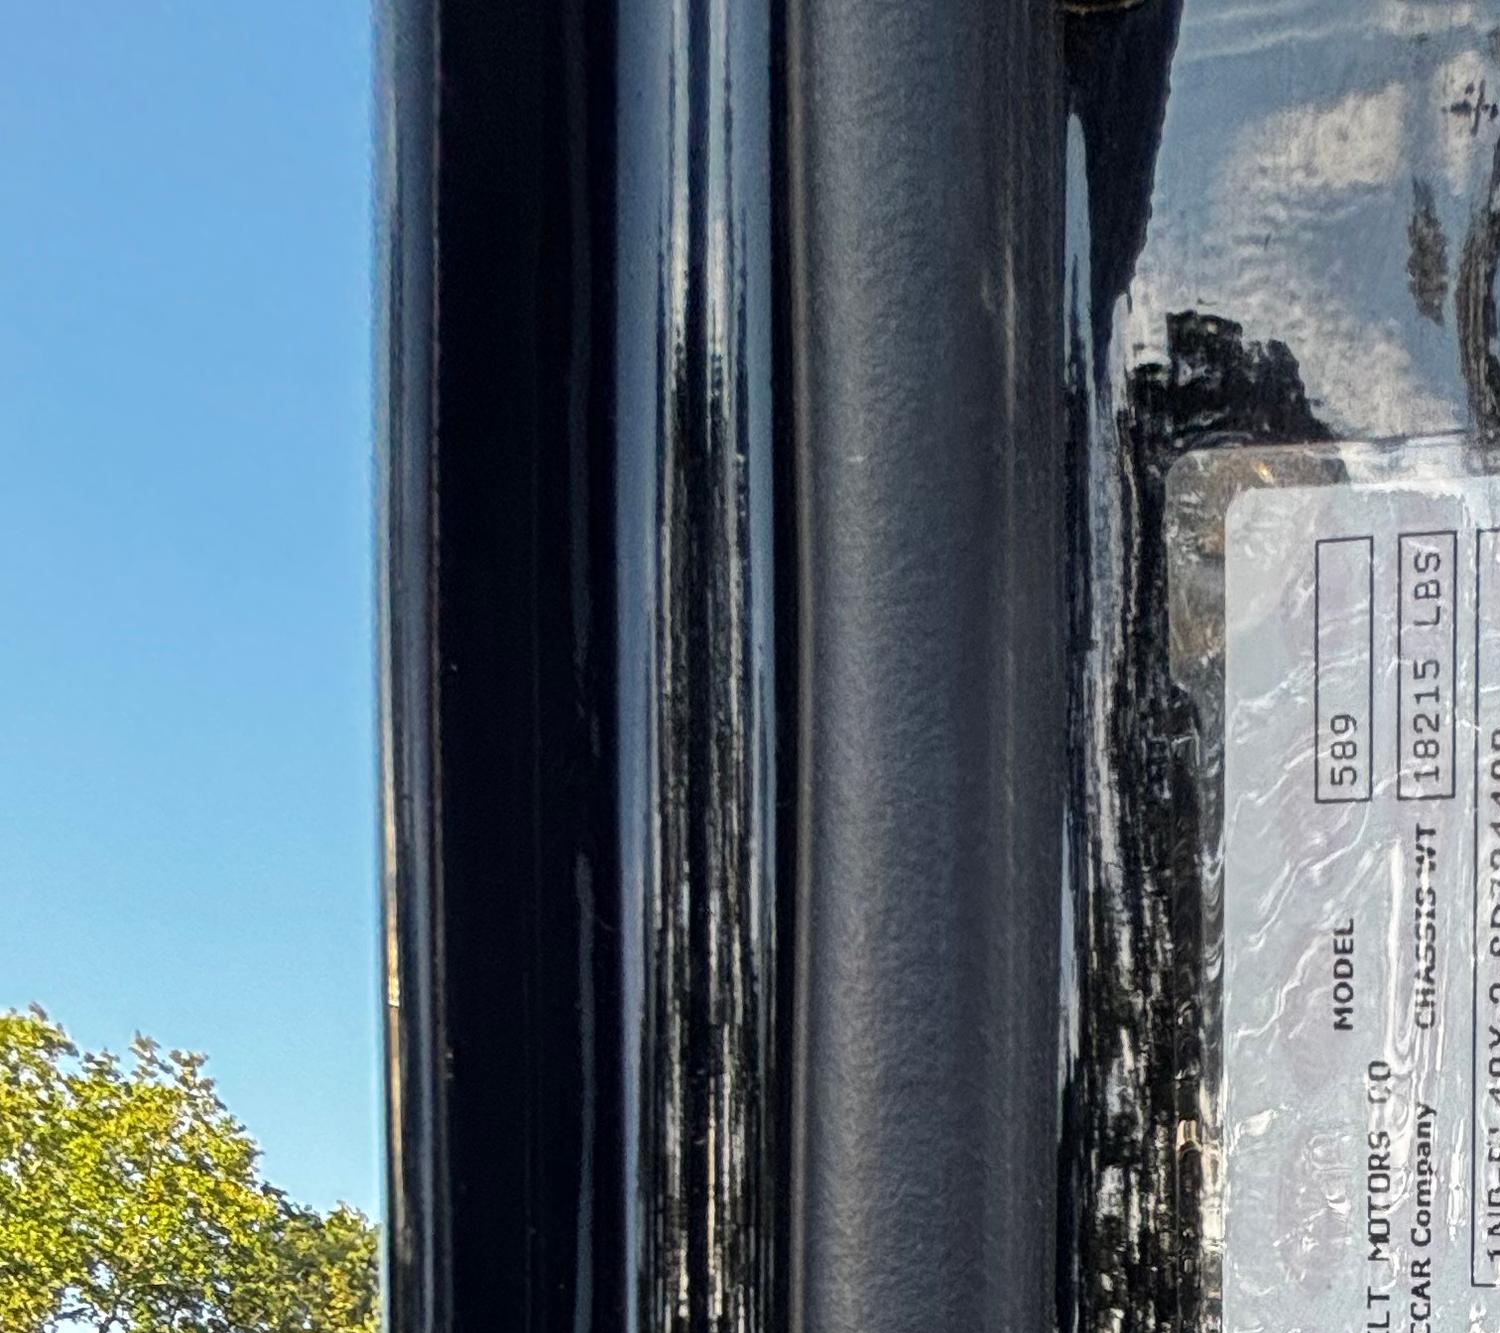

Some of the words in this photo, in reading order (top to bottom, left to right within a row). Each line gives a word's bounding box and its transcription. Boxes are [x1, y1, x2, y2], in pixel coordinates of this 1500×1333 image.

[1412, 550, 1442, 625] LBS
[1329, 712, 1358, 786] 589
[1412, 658, 1441, 783] 18215
[1414, 821, 1437, 875] WT
[1331, 917, 1355, 1031] MODEL
[1414, 885, 1437, 1030] CHASSIS
[1366, 1059, 1391, 1103] CO
[1366, 1129, 1391, 1261] MOTORS
[1409, 1100, 1437, 1247] Company
